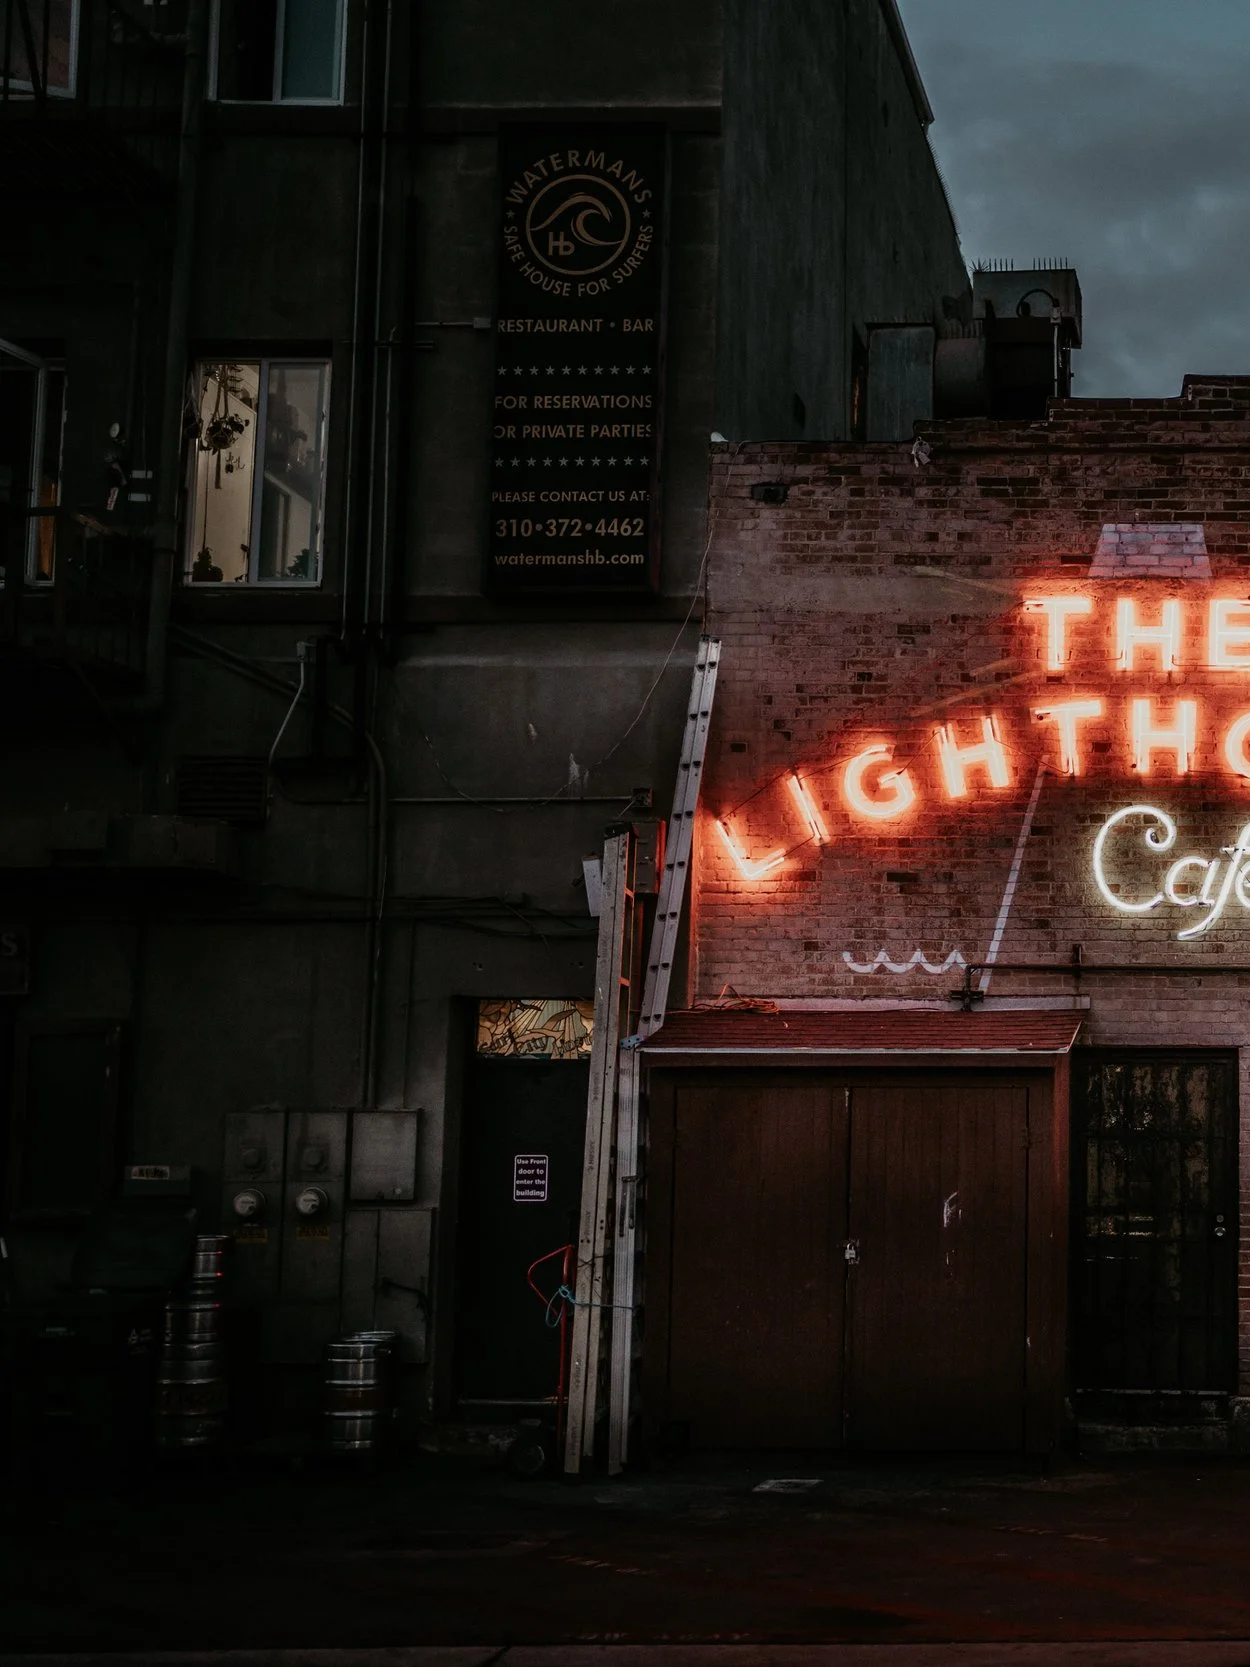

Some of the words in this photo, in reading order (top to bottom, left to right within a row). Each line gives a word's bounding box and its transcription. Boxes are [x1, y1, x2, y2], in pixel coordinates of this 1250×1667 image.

[505, 150, 653, 204] WATERMANS
[503, 224, 526, 264] SAFE
[518, 261, 572, 297] HOUSE
[577, 277, 612, 297] FOR
[611, 224, 654, 284] SURFERS
[498, 318, 604, 332] RESTAURANT
[622, 318, 654, 332] BAR
[494, 395, 528, 409] FOR
[533, 395, 653, 409] RESERVATIONS
[522, 424, 585, 439] PRIVATE
[491, 490, 536, 503] PLEASE
[540, 490, 605, 502] CONTACT
[608, 490, 626, 502] US
[629, 490, 651, 502] AT:
[494, 549, 645, 566] watermanshb.com
[516, 1189, 545, 1197] building
